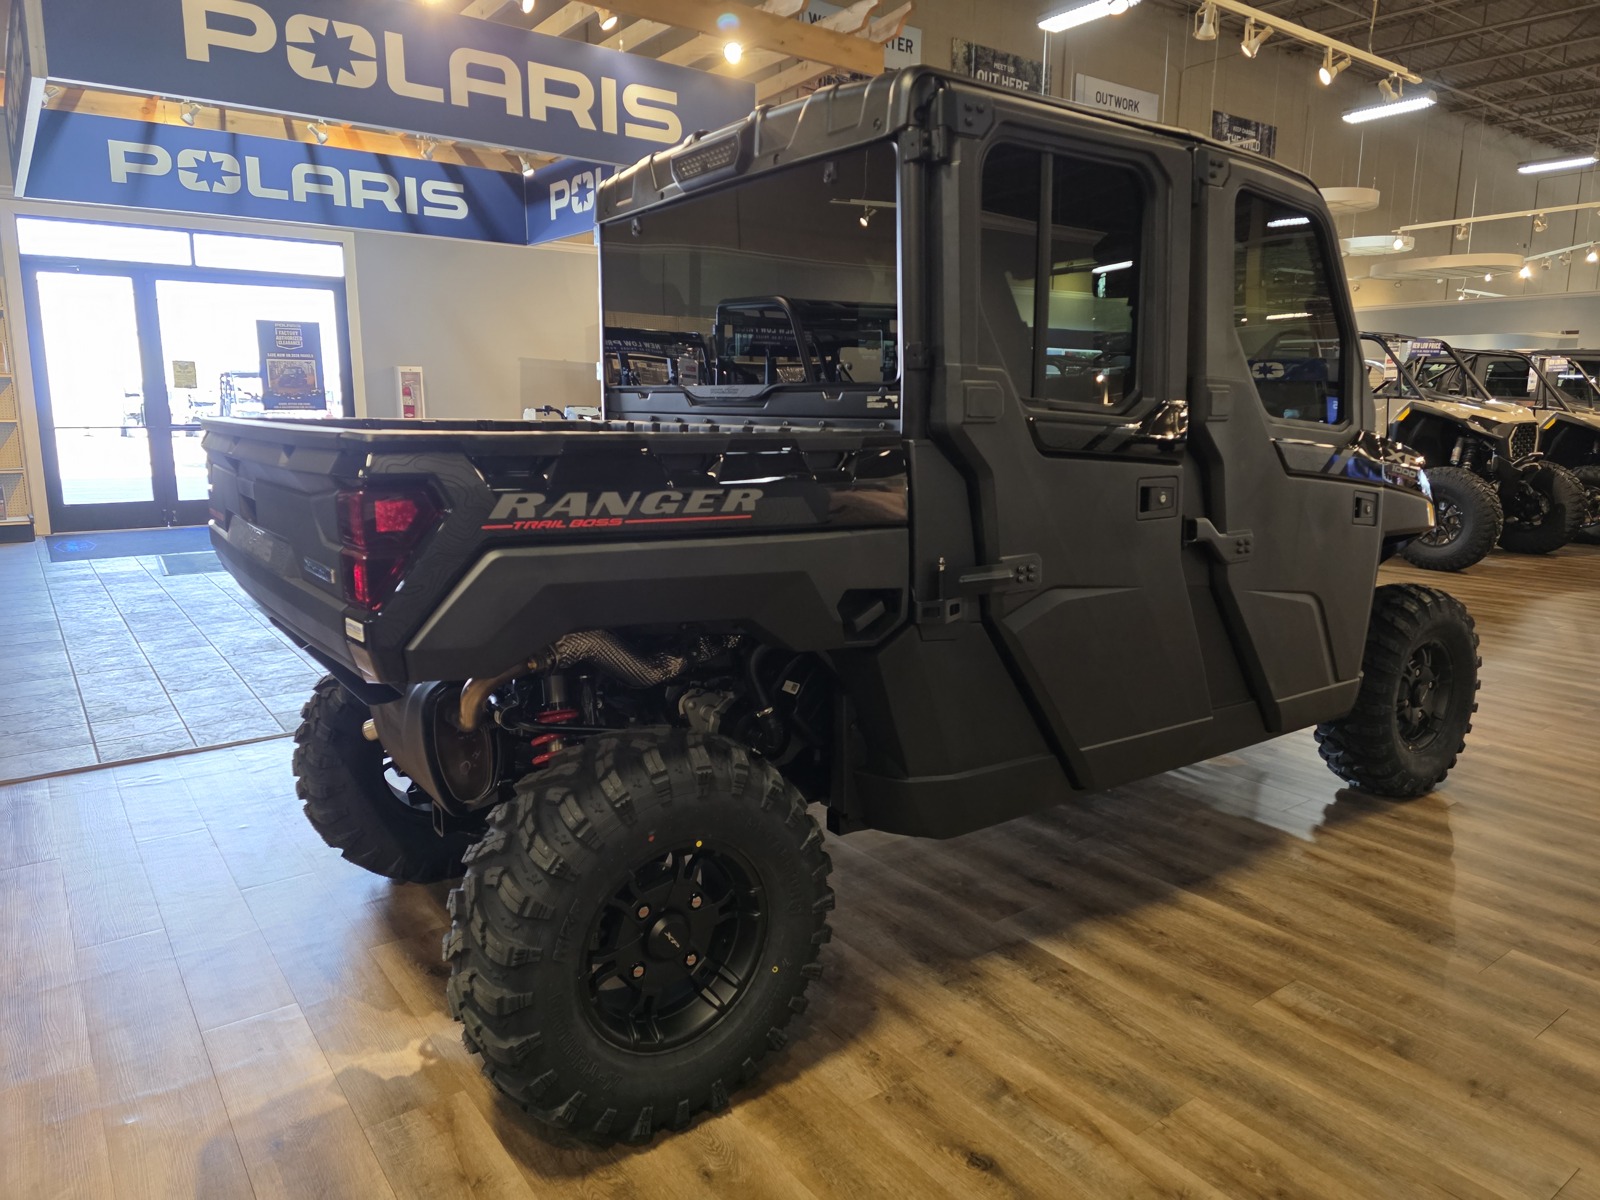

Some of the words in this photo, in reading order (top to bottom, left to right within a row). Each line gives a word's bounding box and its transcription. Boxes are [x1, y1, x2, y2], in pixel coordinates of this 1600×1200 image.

[183, 0, 683, 144] POLARIS
[1095, 91, 1140, 113] OUTWORK
[107, 139, 469, 220] POLARIS
[1391, 464, 1417, 478] 1000
[488, 488, 764, 519] RANGER
[511, 519, 567, 530] TRAIL
[569, 517, 624, 528] BOSS
